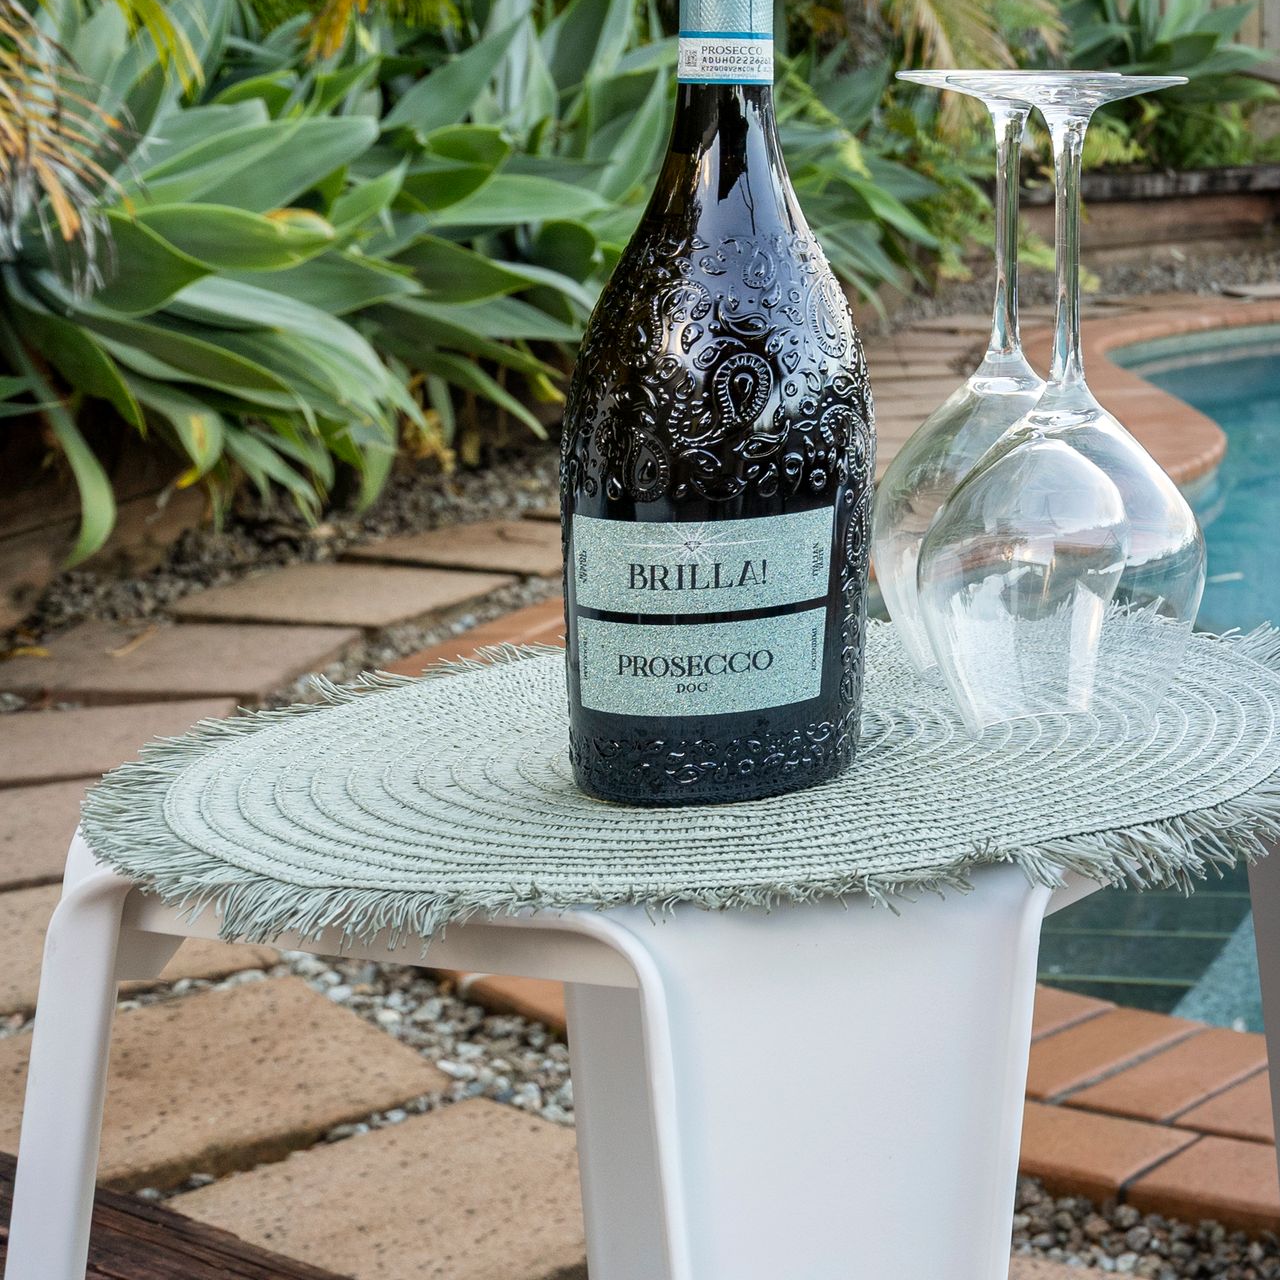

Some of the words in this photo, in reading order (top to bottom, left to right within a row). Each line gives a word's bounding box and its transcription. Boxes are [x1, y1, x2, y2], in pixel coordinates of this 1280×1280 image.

[701, 45, 763, 55] PROSECCO
[628, 559, 767, 591] BRILLA!
[617, 649, 774, 678] PROSECCO
